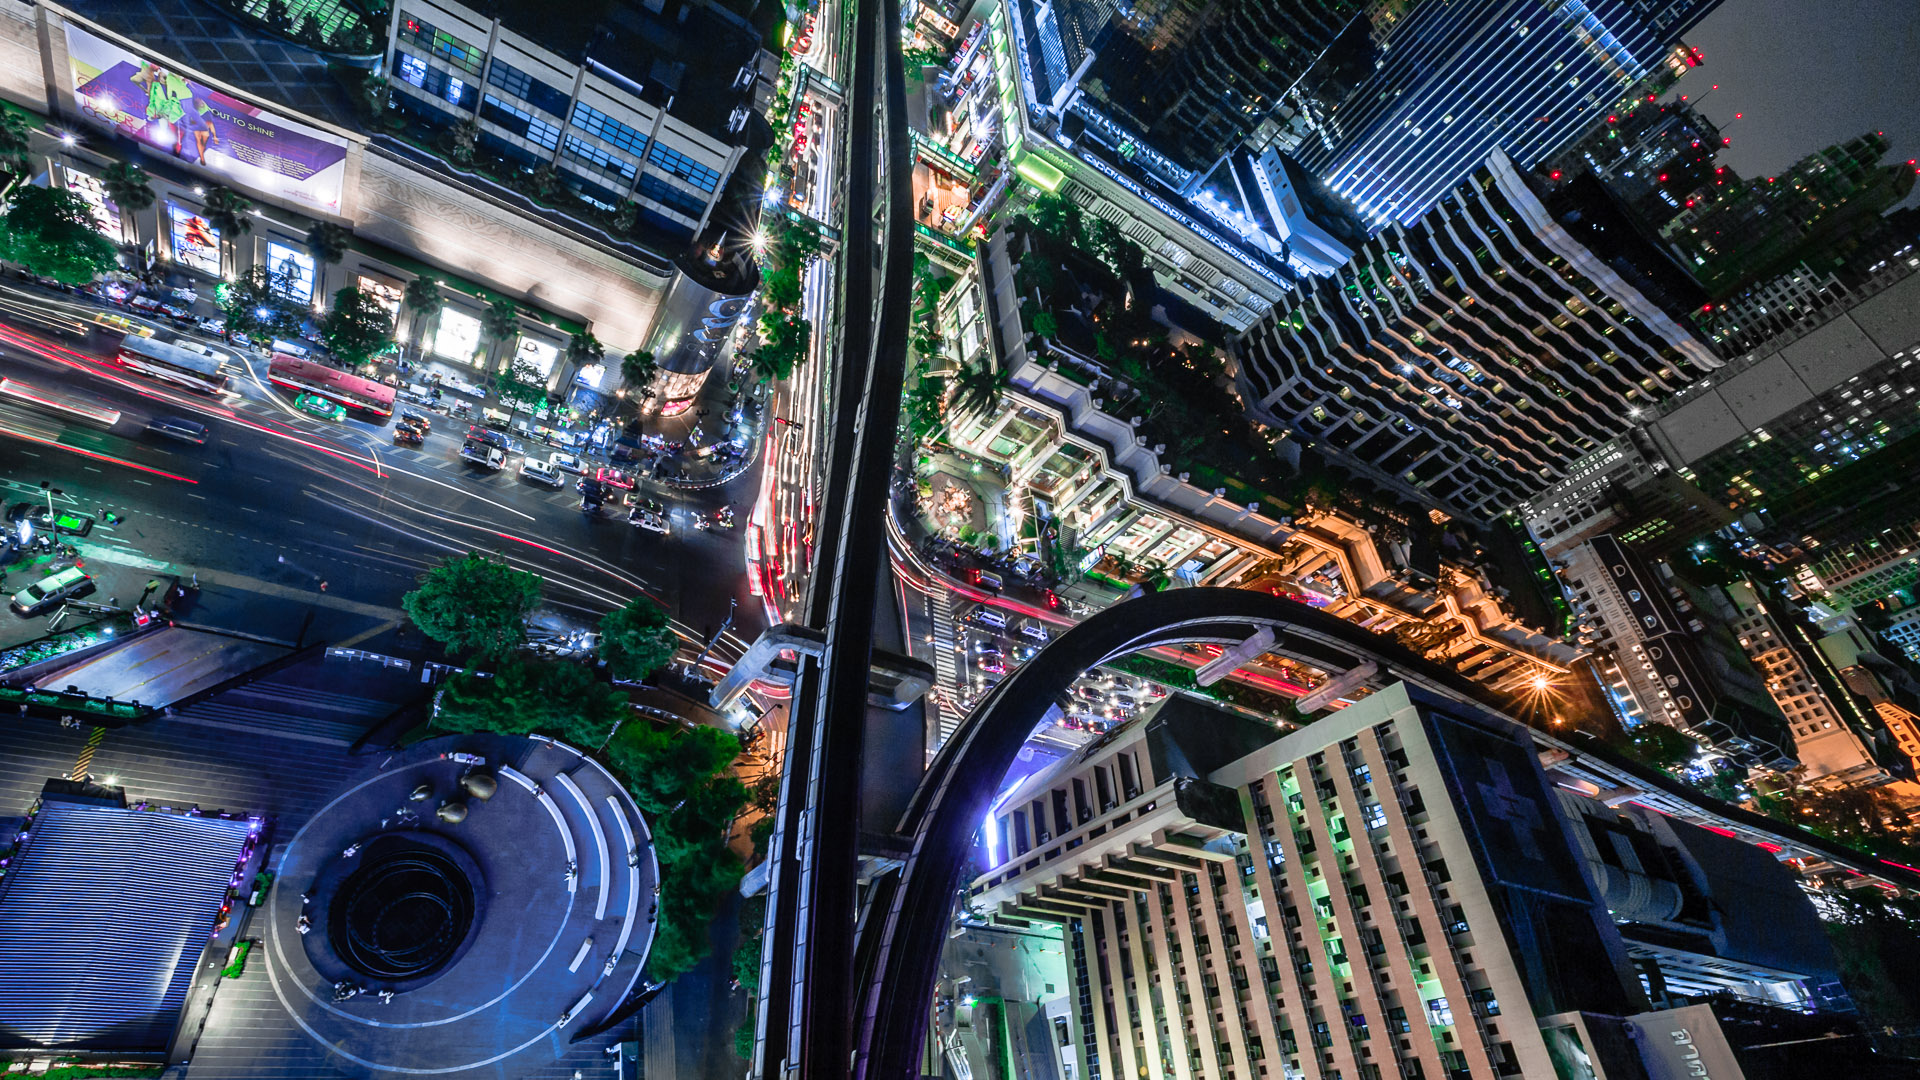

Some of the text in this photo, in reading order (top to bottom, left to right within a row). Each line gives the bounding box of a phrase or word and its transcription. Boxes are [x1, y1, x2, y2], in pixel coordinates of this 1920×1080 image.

[232, 117, 246, 127] TO
[247, 123, 275, 138] SHINE
[1671, 1028, 1711, 1080] อาค
